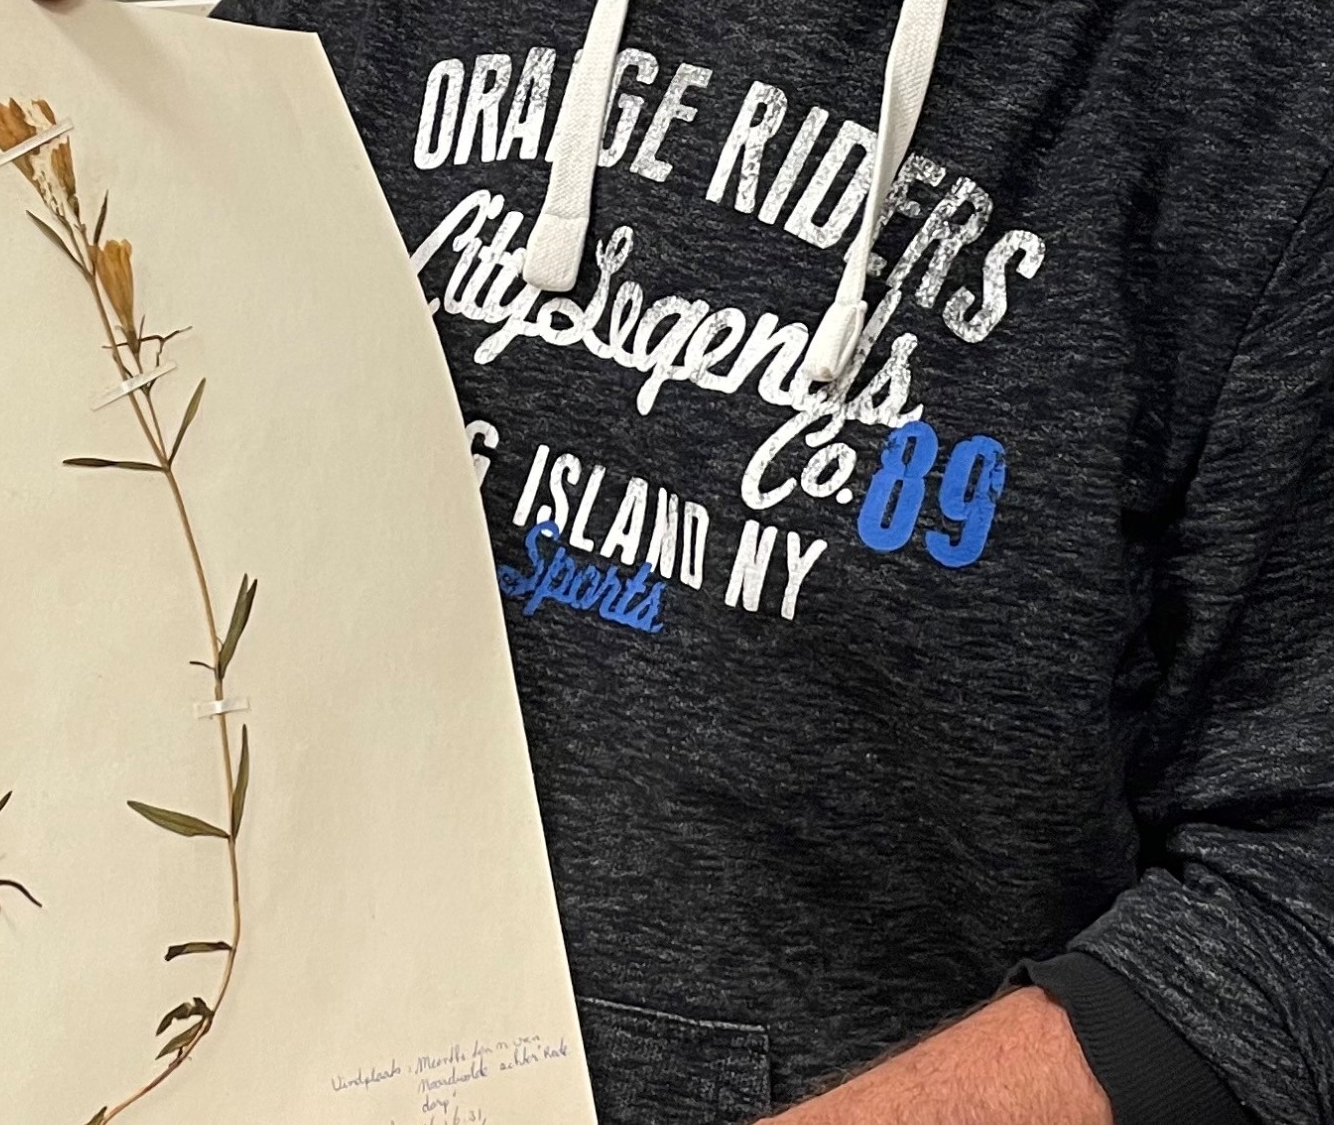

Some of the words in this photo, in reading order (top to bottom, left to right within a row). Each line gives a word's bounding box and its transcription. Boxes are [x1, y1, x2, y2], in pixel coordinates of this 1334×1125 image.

[413, 47, 713, 182] ORAGE
[705, 80, 1046, 345] RIDERS
[512, 444, 710, 591] ISLAND
[723, 518, 828, 621] NY
[741, 405, 853, 511] Co.
[857, 420, 1008, 568] 89
[497, 519, 666, 634] Sports
